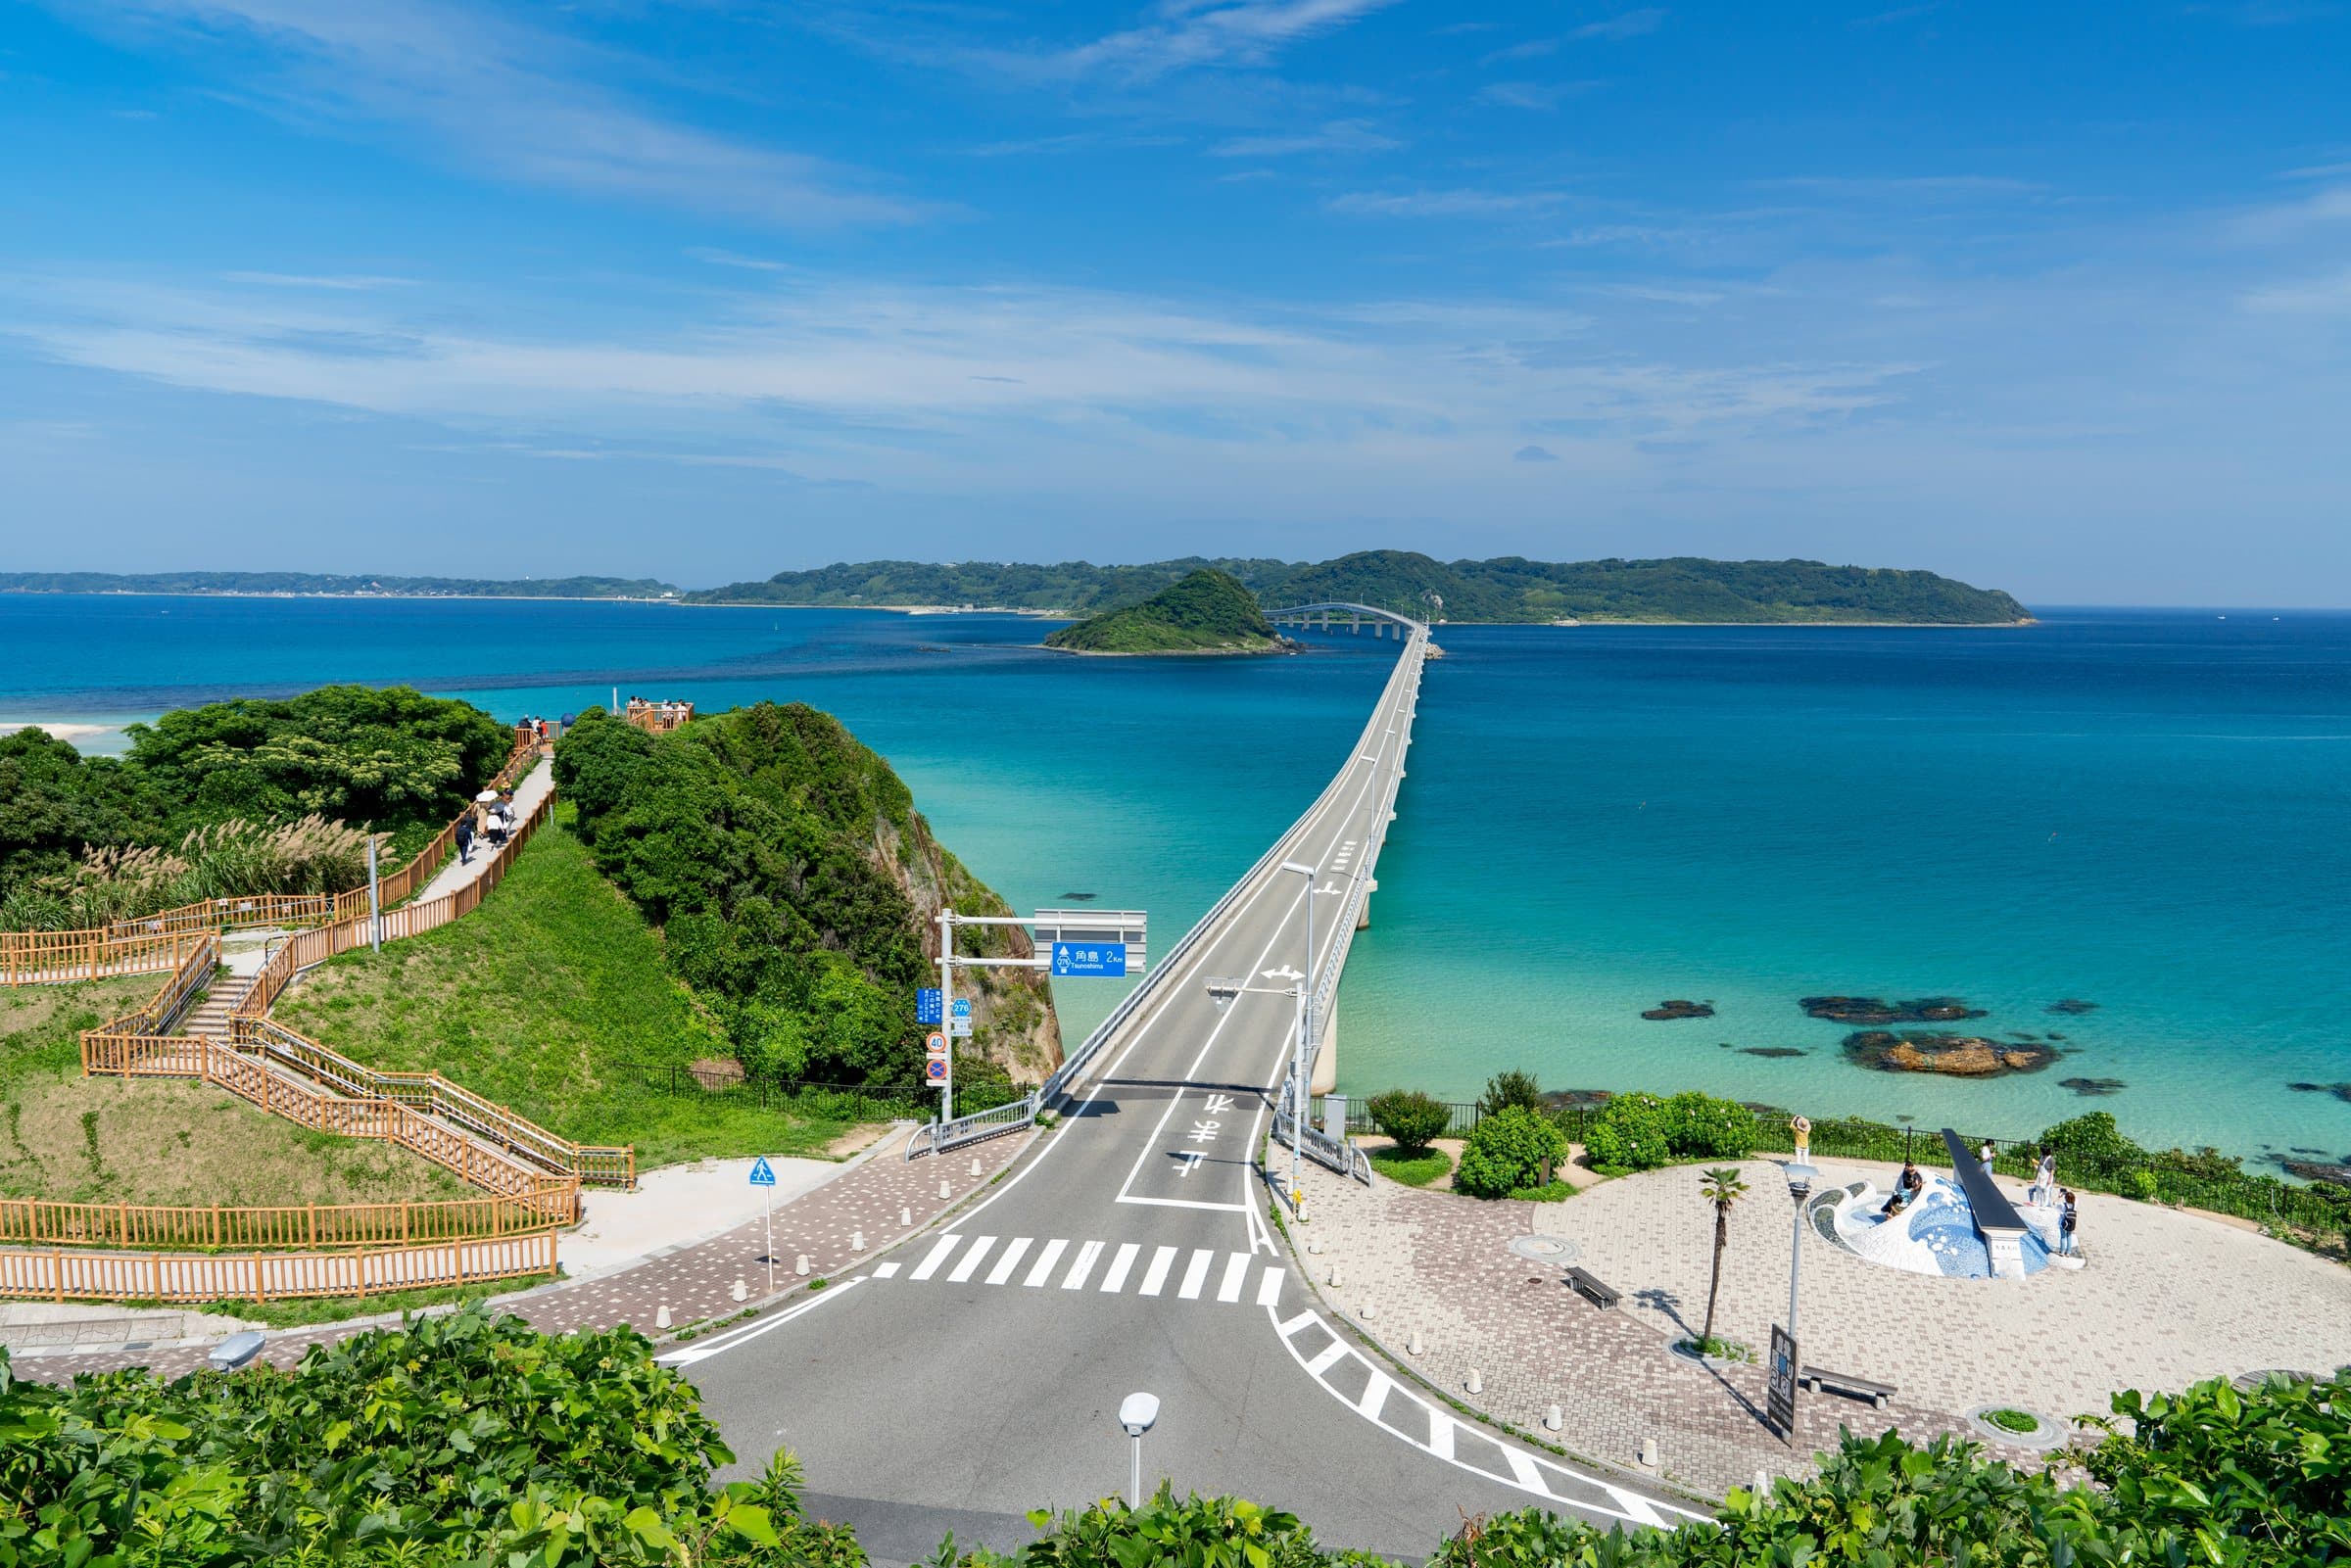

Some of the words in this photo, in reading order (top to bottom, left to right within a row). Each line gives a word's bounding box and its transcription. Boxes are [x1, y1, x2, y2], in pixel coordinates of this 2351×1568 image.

[1076, 951, 1099, 963] 角島
[932, 1038, 942, 1047] 40
[1172, 1094, 1234, 1177] 止まれ
